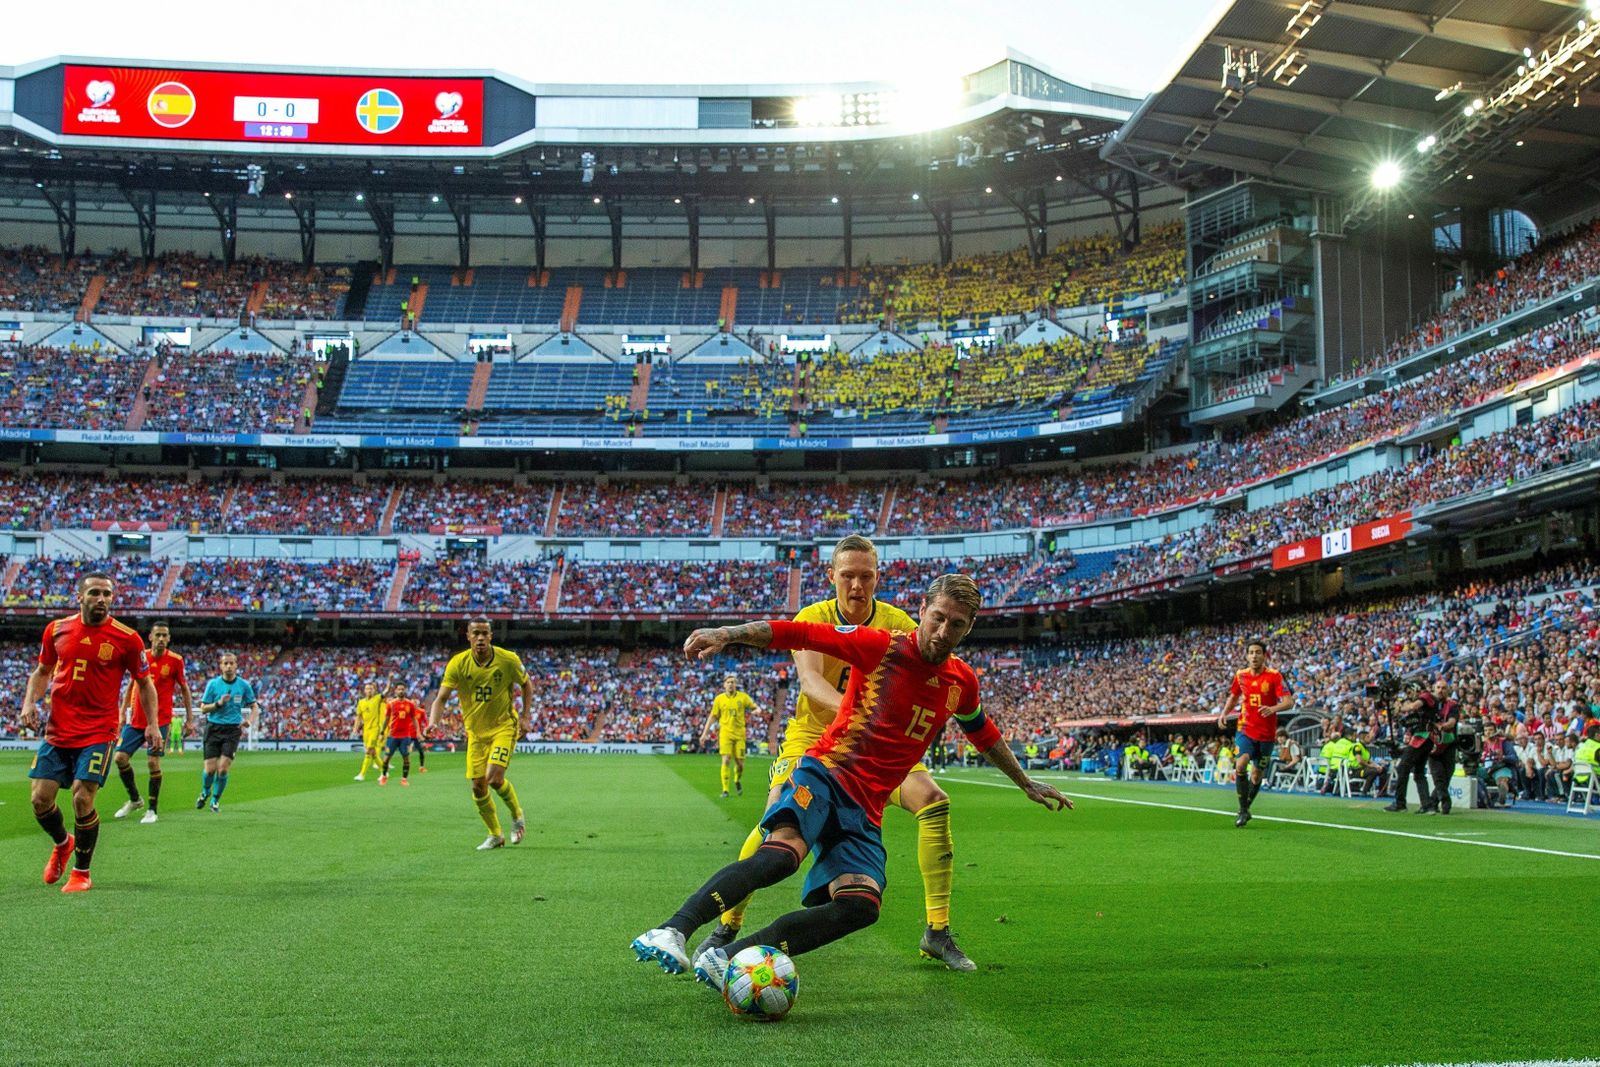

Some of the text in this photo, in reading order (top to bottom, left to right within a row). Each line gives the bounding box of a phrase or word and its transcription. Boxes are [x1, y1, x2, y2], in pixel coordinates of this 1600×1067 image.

[257, 101, 267, 117] 0
[286, 102, 295, 118] 0
[1061, 418, 1102, 431] Real Madrid
[0, 429, 31, 439] Madrid
[81, 433, 135, 442] Real Madrid
[185, 433, 236, 442] Real Madrid
[972, 429, 1018, 441] Real Madrid
[284, 437, 337, 445] Real Madrid
[385, 437, 435, 446] Real Madrid
[504, 439, 534, 447] Madrid
[582, 439, 633, 447] Real Madrid
[679, 440, 730, 448] Real Madrid
[779, 439, 828, 448] Real Madrid
[876, 437, 925, 446] Real Madrid
[1325, 536, 1331, 555] 0
[1342, 532, 1347, 551] 0
[72, 658, 88, 681] 2
[475, 686, 492, 702] 22
[1249, 694, 1262, 707] 21
[904, 704, 936, 742] 15
[591, 745, 598, 753] 7
[491, 746, 509, 763] 22
[88, 751, 104, 774] 2
